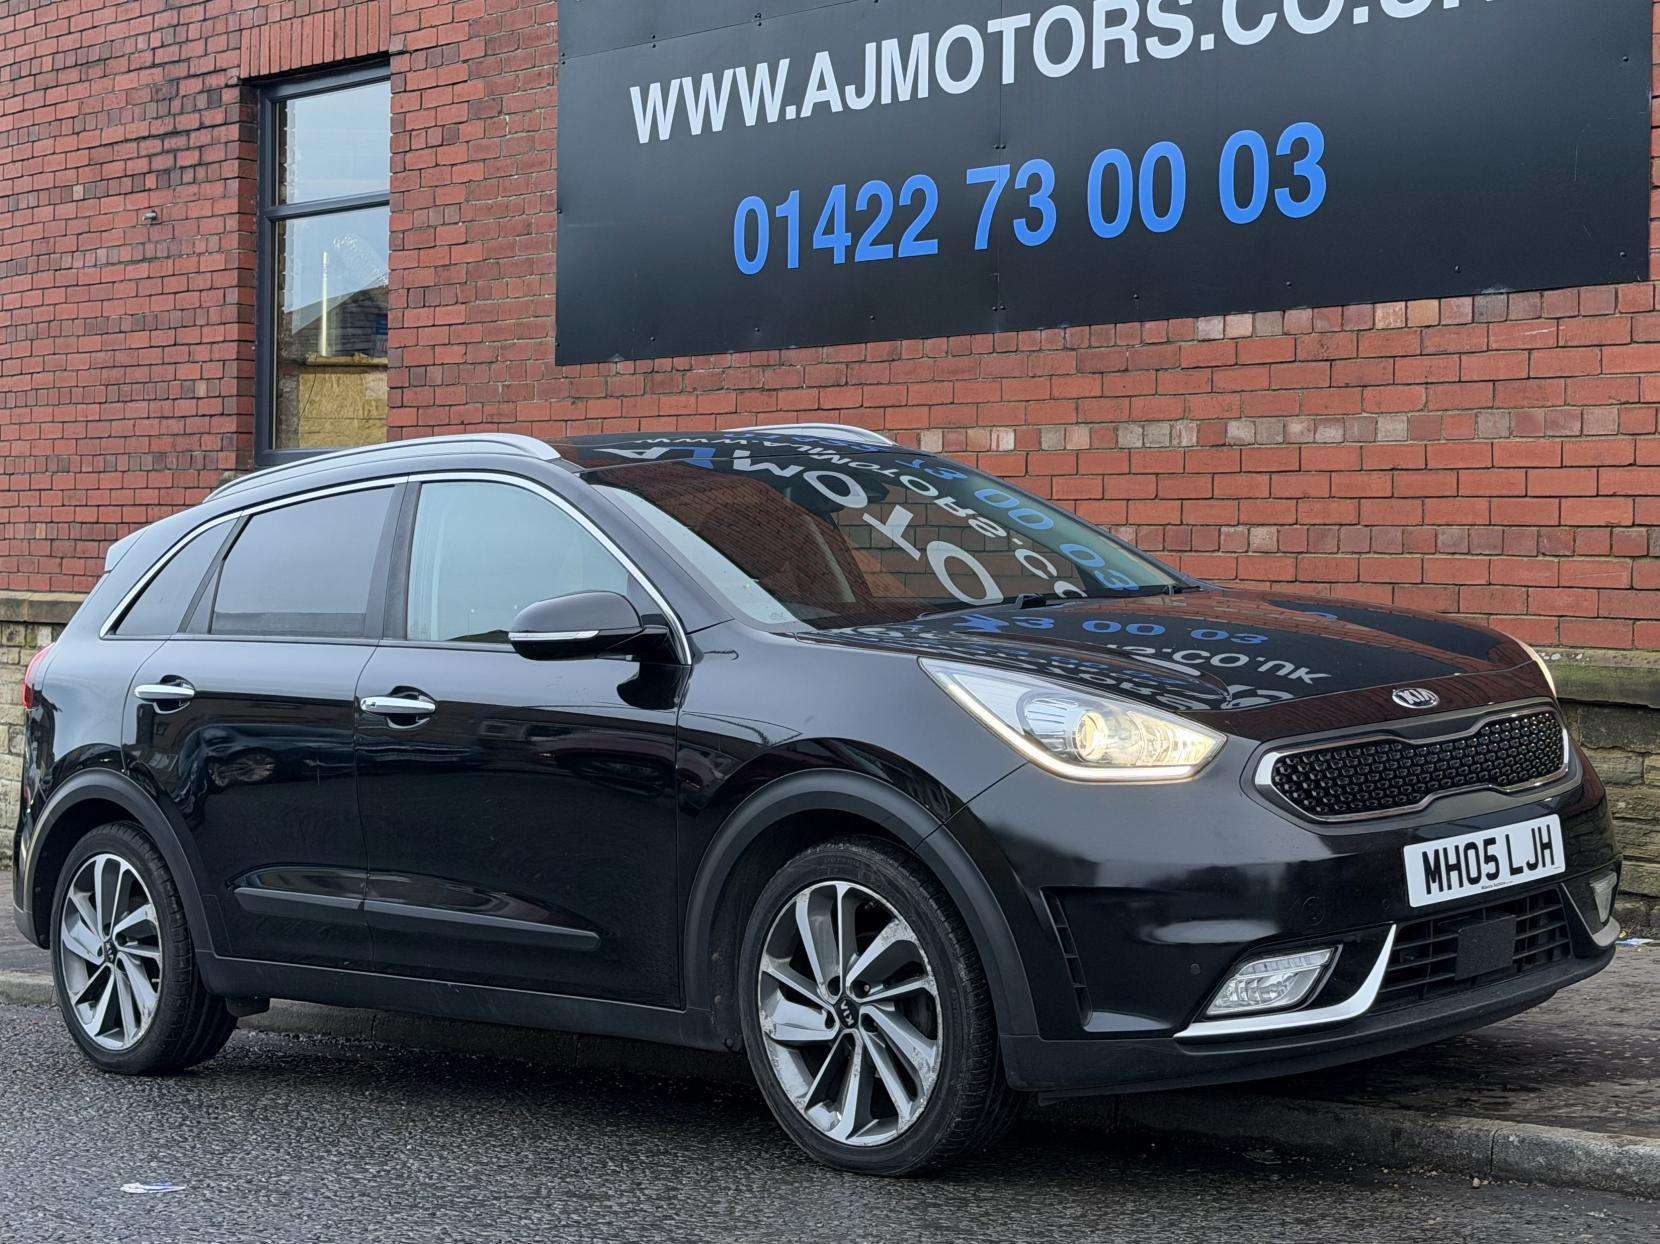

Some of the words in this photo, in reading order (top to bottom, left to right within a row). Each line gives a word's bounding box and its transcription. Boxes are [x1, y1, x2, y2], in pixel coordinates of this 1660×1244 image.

[630, 0, 1493, 143] WWW.AJMOTORS.C.
[734, 175, 938, 274] 01422
[968, 160, 1057, 250] 73
[1088, 141, 1186, 238] 00
[1219, 122, 1326, 224] 03
[1421, 836, 1500, 895] MH05
[1505, 824, 1555, 876] LJH
[840, 999, 855, 1026] KIA
